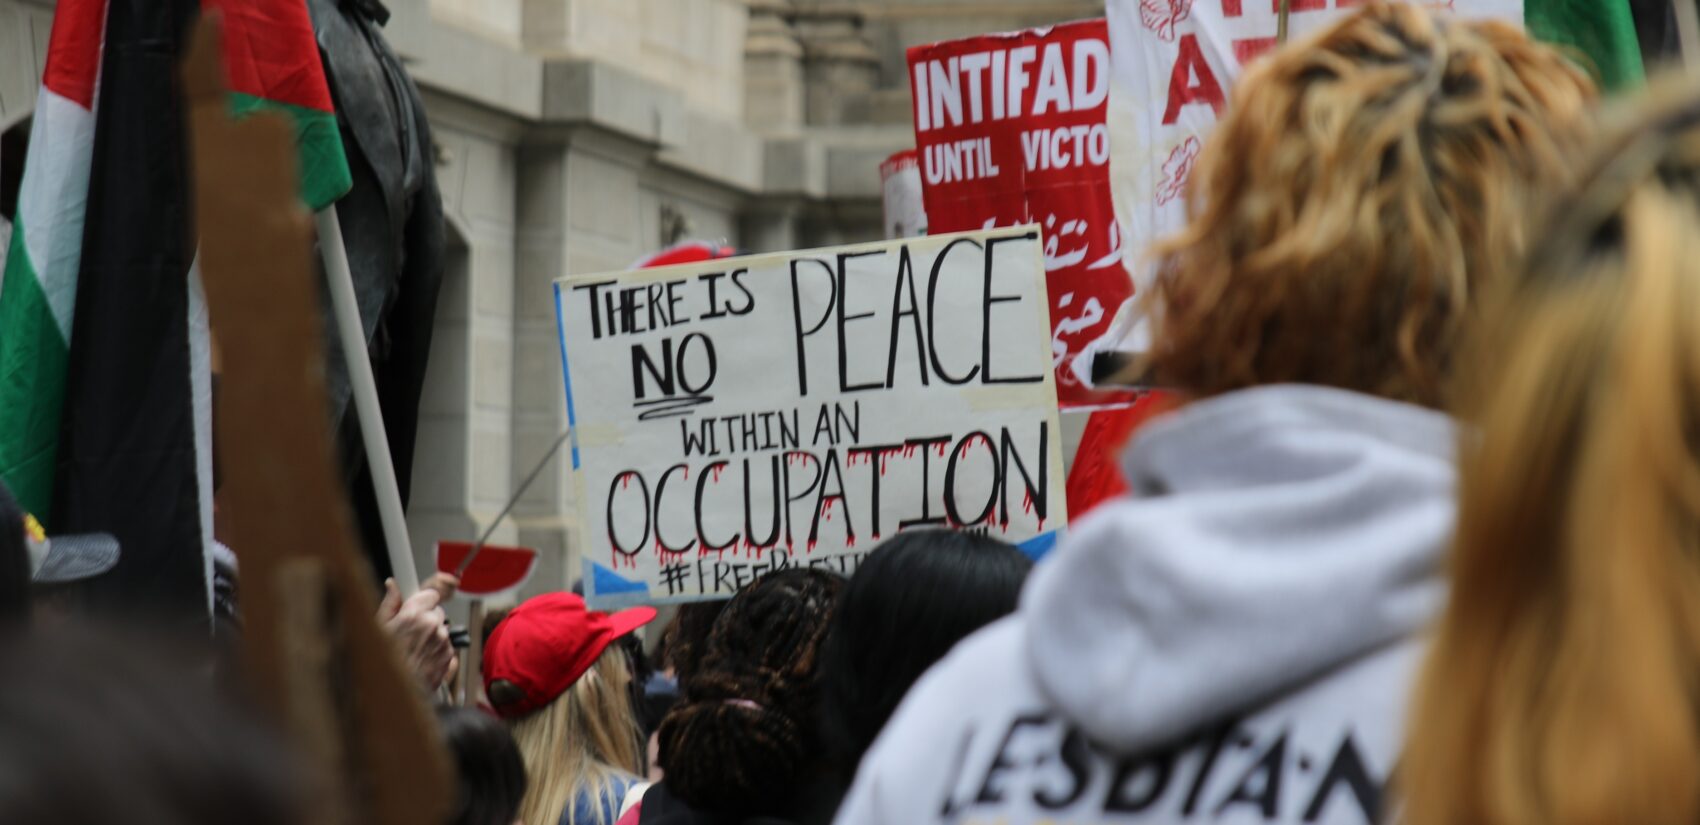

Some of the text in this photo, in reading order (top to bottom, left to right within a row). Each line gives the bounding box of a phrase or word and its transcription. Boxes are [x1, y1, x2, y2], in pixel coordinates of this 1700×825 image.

[914, 39, 1109, 132] INTIFAD
[924, 123, 1109, 186] UNTIL VICTO
[573, 268, 755, 339] THERE IS
[630, 231, 1044, 400] NO PEACE
[682, 401, 860, 457] WITHIN AN
[606, 421, 1049, 556] OCCUPATION
